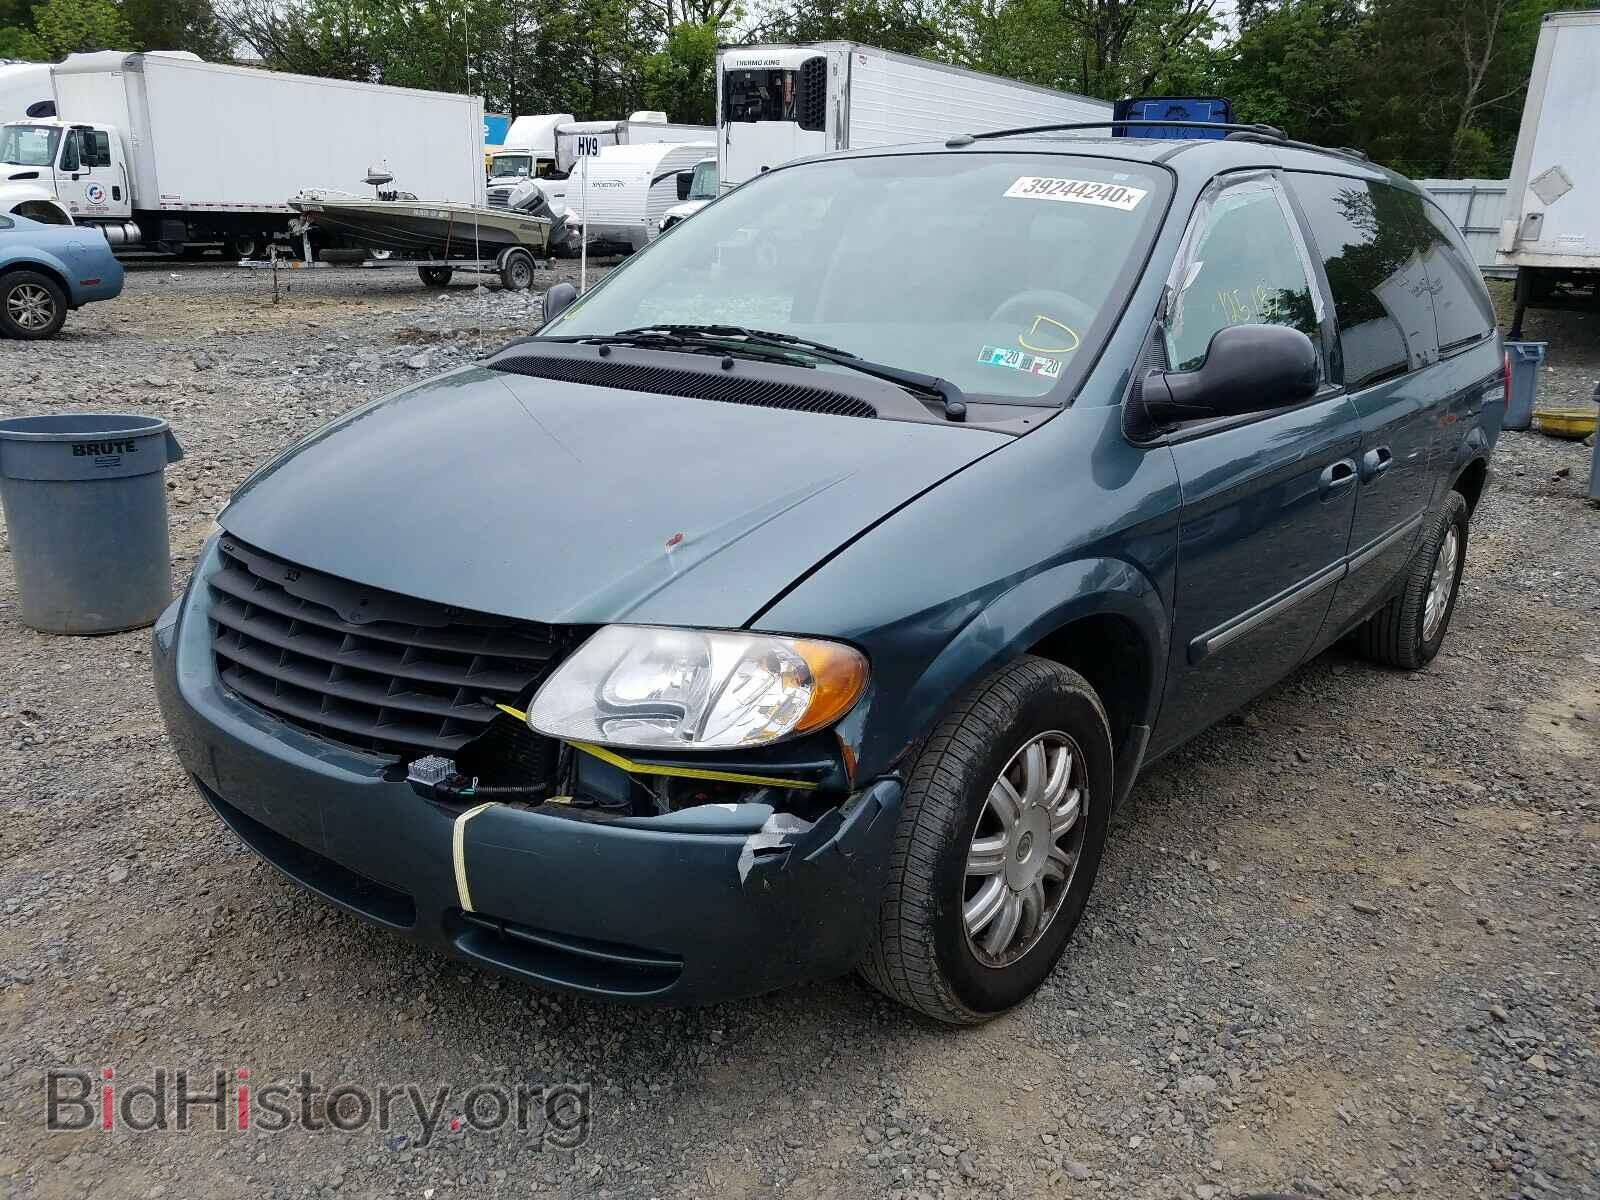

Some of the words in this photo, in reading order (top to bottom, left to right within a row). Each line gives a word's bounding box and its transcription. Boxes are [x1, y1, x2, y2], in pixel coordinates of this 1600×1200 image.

[578, 136, 598, 156] HV9
[1006, 351, 1020, 365] 20
[1045, 359, 1060, 374] 20
[72, 439, 137, 457] BRUTE
